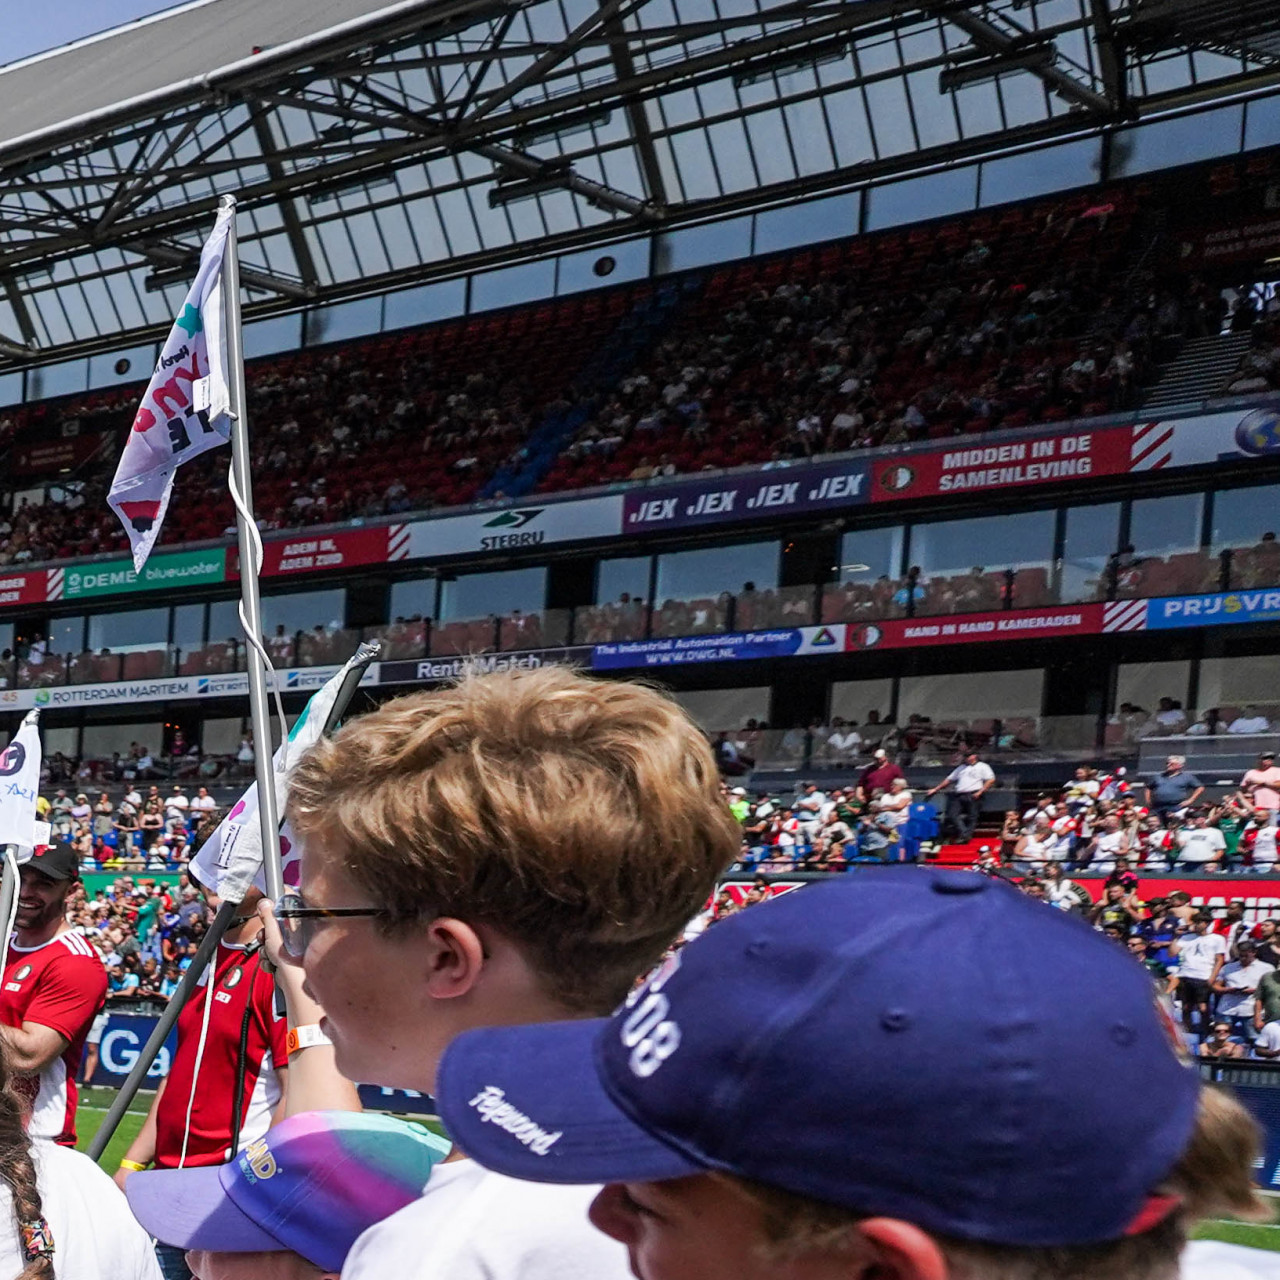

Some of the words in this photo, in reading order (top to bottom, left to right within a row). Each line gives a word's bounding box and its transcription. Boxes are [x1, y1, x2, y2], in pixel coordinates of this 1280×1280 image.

[943, 449, 1025, 470] MIDDEN
[1031, 440, 1056, 458] IN
[1061, 435, 1092, 454] DE
[939, 458, 1092, 491] SAMENLEVING
[630, 499, 679, 522] JEX
[686, 490, 738, 516] JEX
[747, 482, 800, 508] JEX
[809, 474, 865, 500] JEX
[480, 530, 544, 551] STEBRU
[83, 570, 137, 589] DEME
[146, 560, 221, 581] bluewater
[279, 556, 313, 571] ADEM
[958, 621, 994, 634] HAND
[997, 614, 1082, 631] KAMERADEN
[597, 644, 616, 655] The
[618, 639, 673, 653] Industrial
[675, 634, 743, 649] Automation
[745, 631, 793, 644] Partner
[53, 687, 127, 704] ROTTERDAM
[130, 683, 188, 698] MARITIEM
